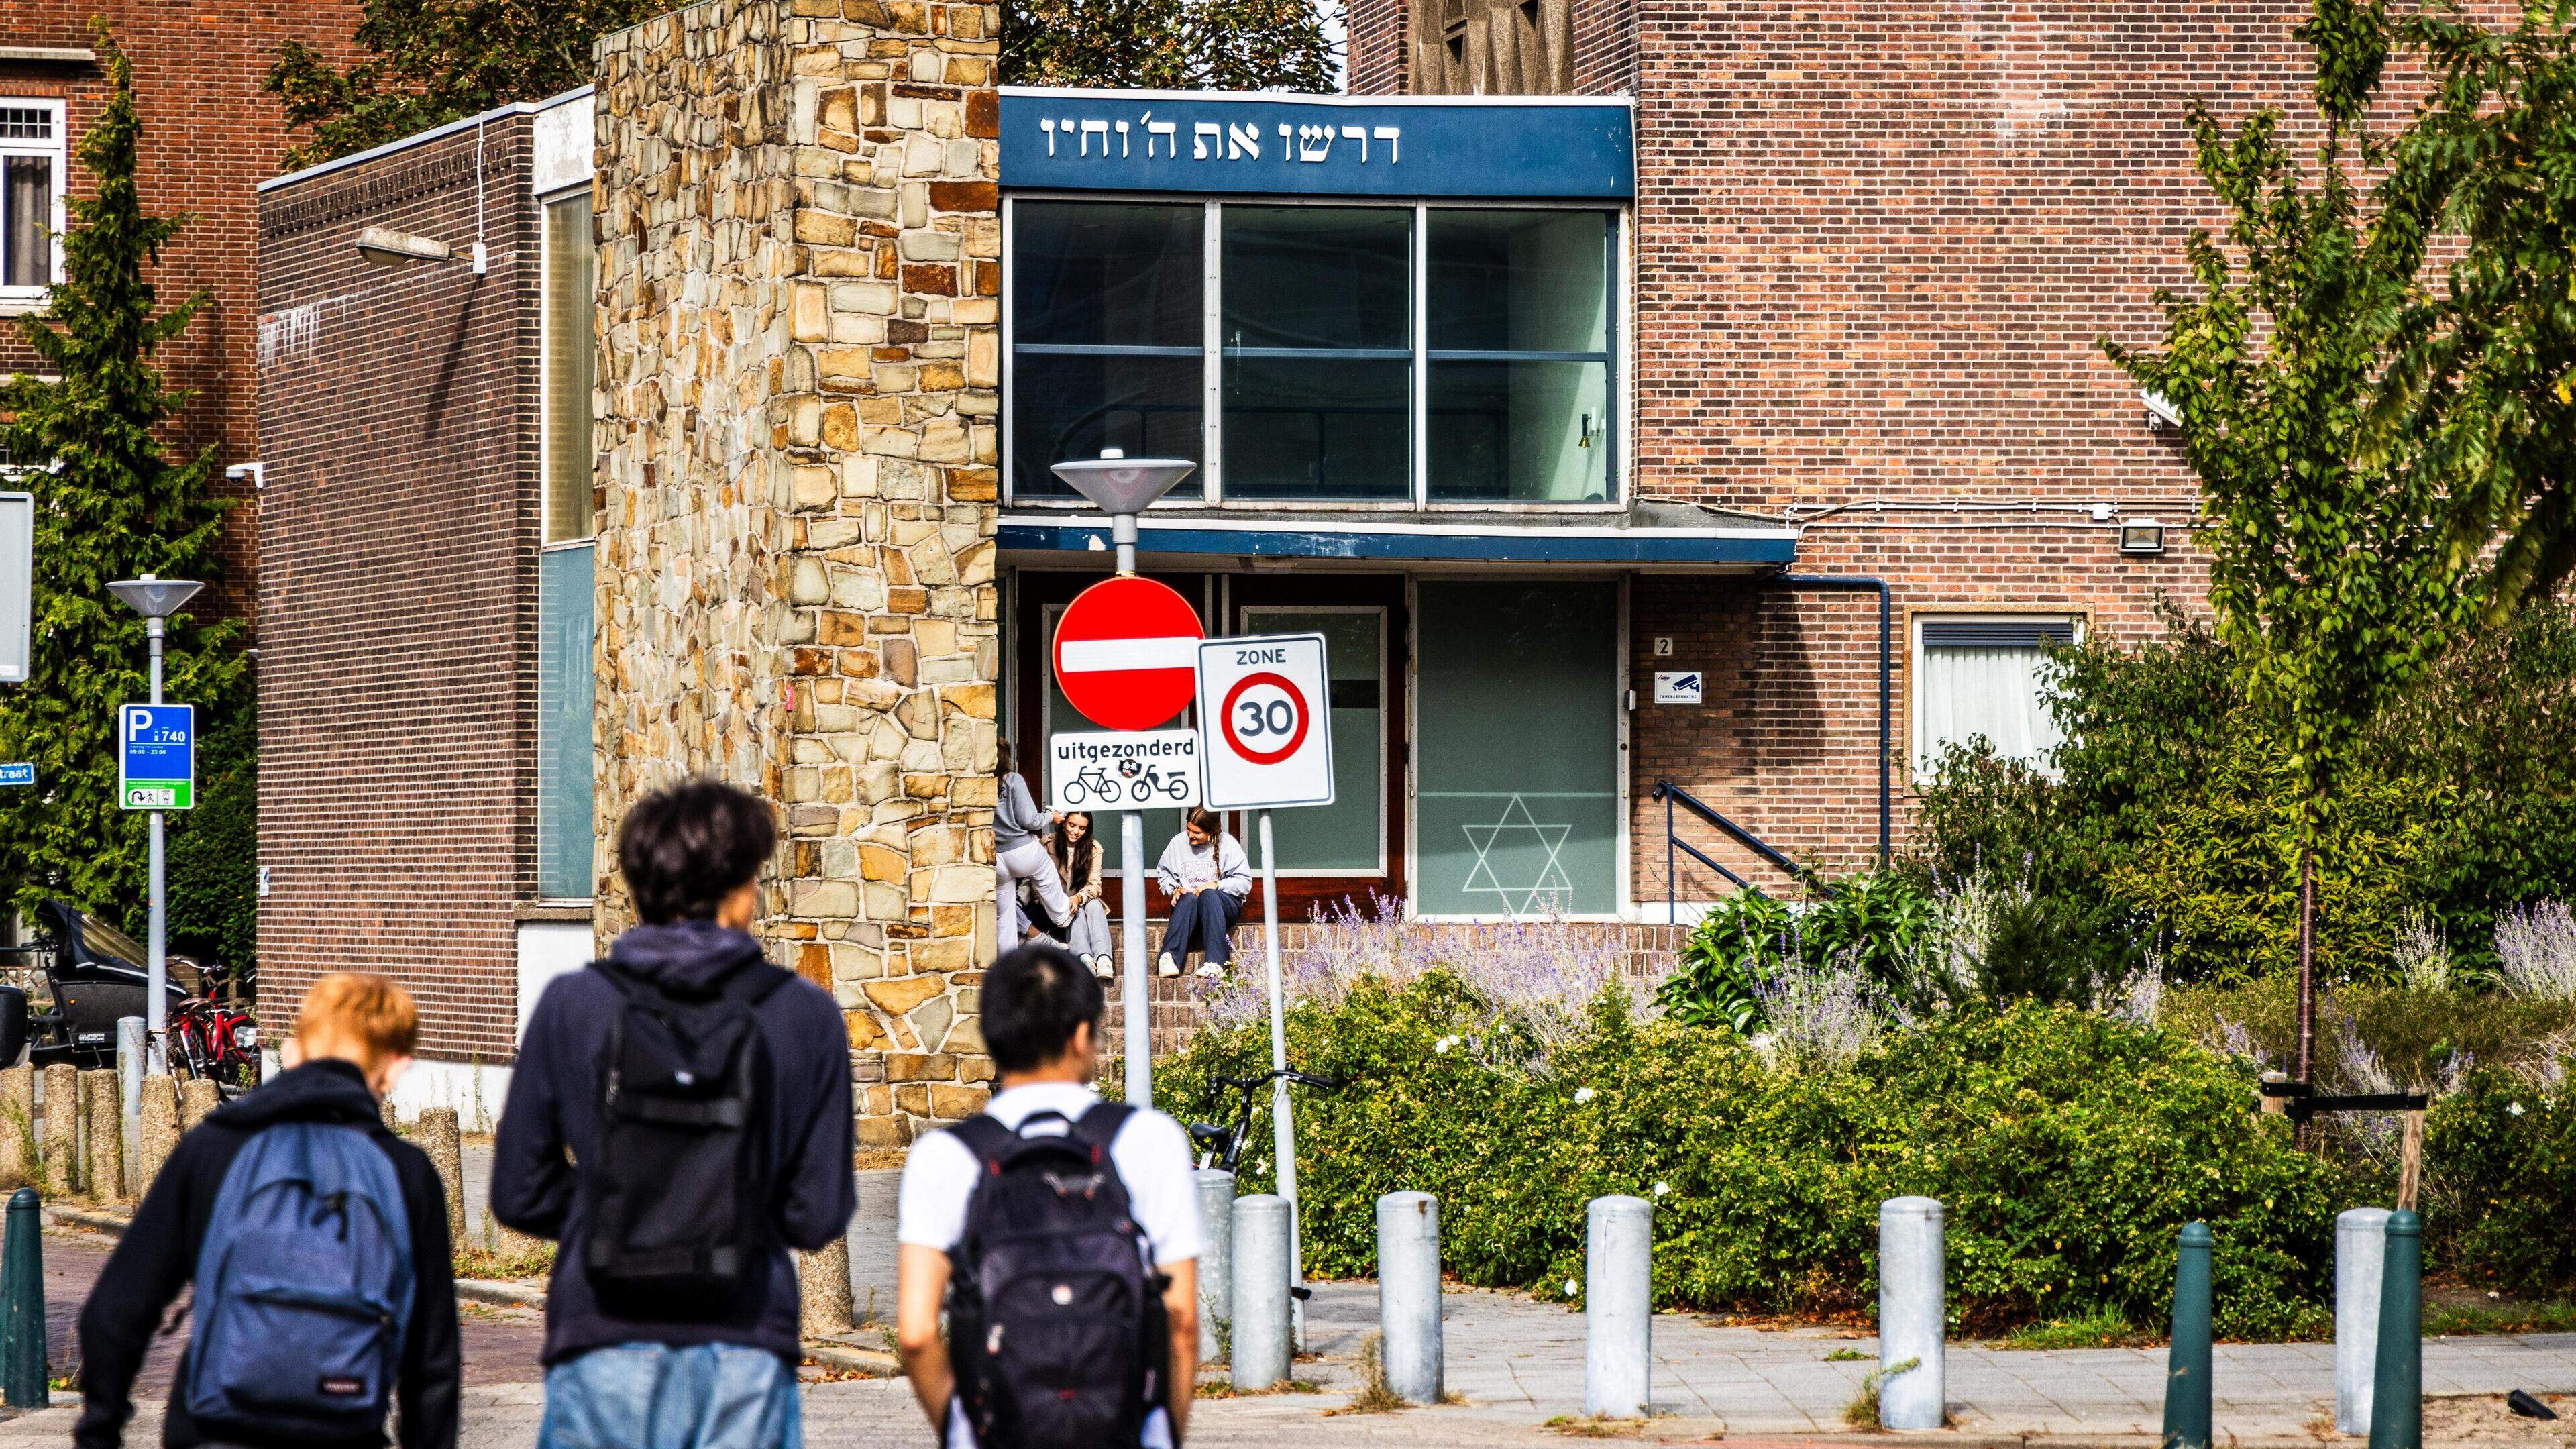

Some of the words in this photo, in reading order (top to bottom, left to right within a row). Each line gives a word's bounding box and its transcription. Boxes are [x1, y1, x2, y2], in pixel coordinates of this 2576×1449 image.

[1040, 118, 1129, 158] וחיו
[1193, 121, 1260, 160] את
[1278, 123, 1400, 164] דרשו
[1236, 649, 1286, 665] ZONE
[1660, 639, 1668, 654] 2
[129, 709, 153, 741] P
[1238, 700, 1293, 737] 30
[161, 731, 186, 742] 740
[1058, 738, 1194, 764] uitgezonderd
